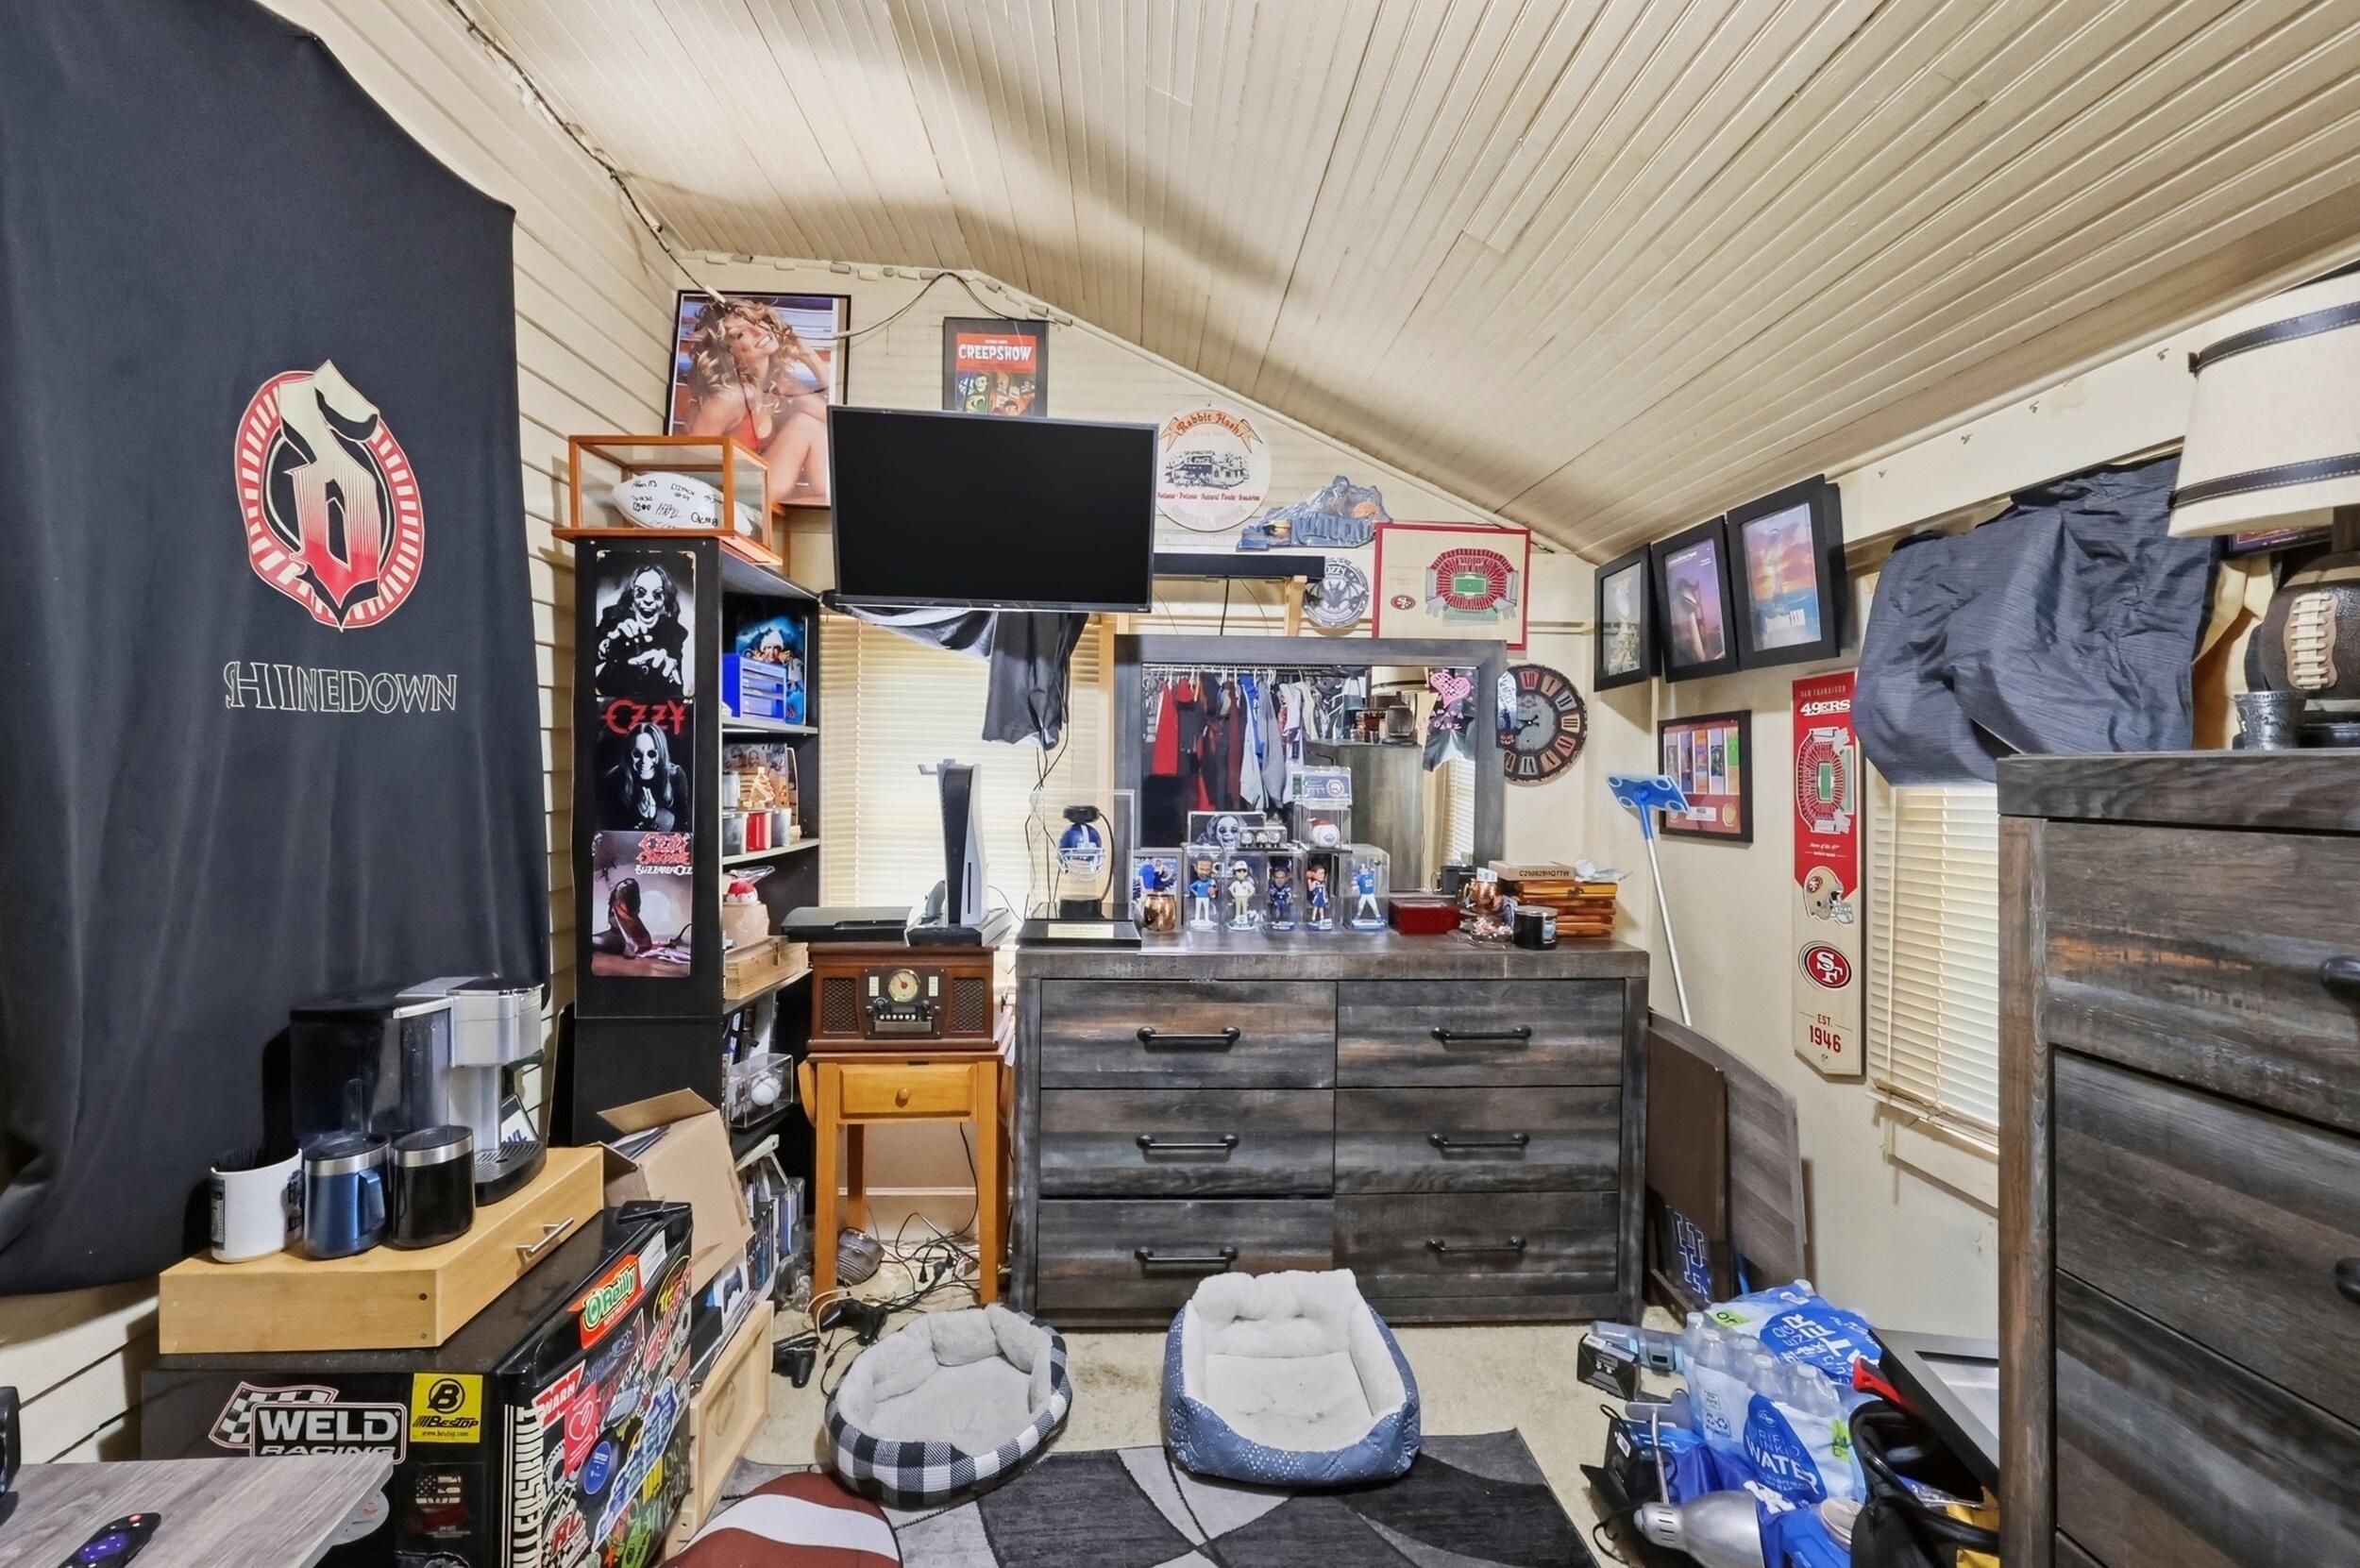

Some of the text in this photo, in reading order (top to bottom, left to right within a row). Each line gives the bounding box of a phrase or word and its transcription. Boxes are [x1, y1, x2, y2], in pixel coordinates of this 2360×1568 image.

[958, 345, 1033, 361] CREEPSHOW
[224, 661, 458, 714] SHINEDOWN
[601, 699, 685, 735] OZZY
[1799, 699, 1851, 717] 49ERS
[1809, 1024, 1841, 1054] 1946
[428, 1384, 460, 1408] B
[259, 1410, 398, 1442] WELD
